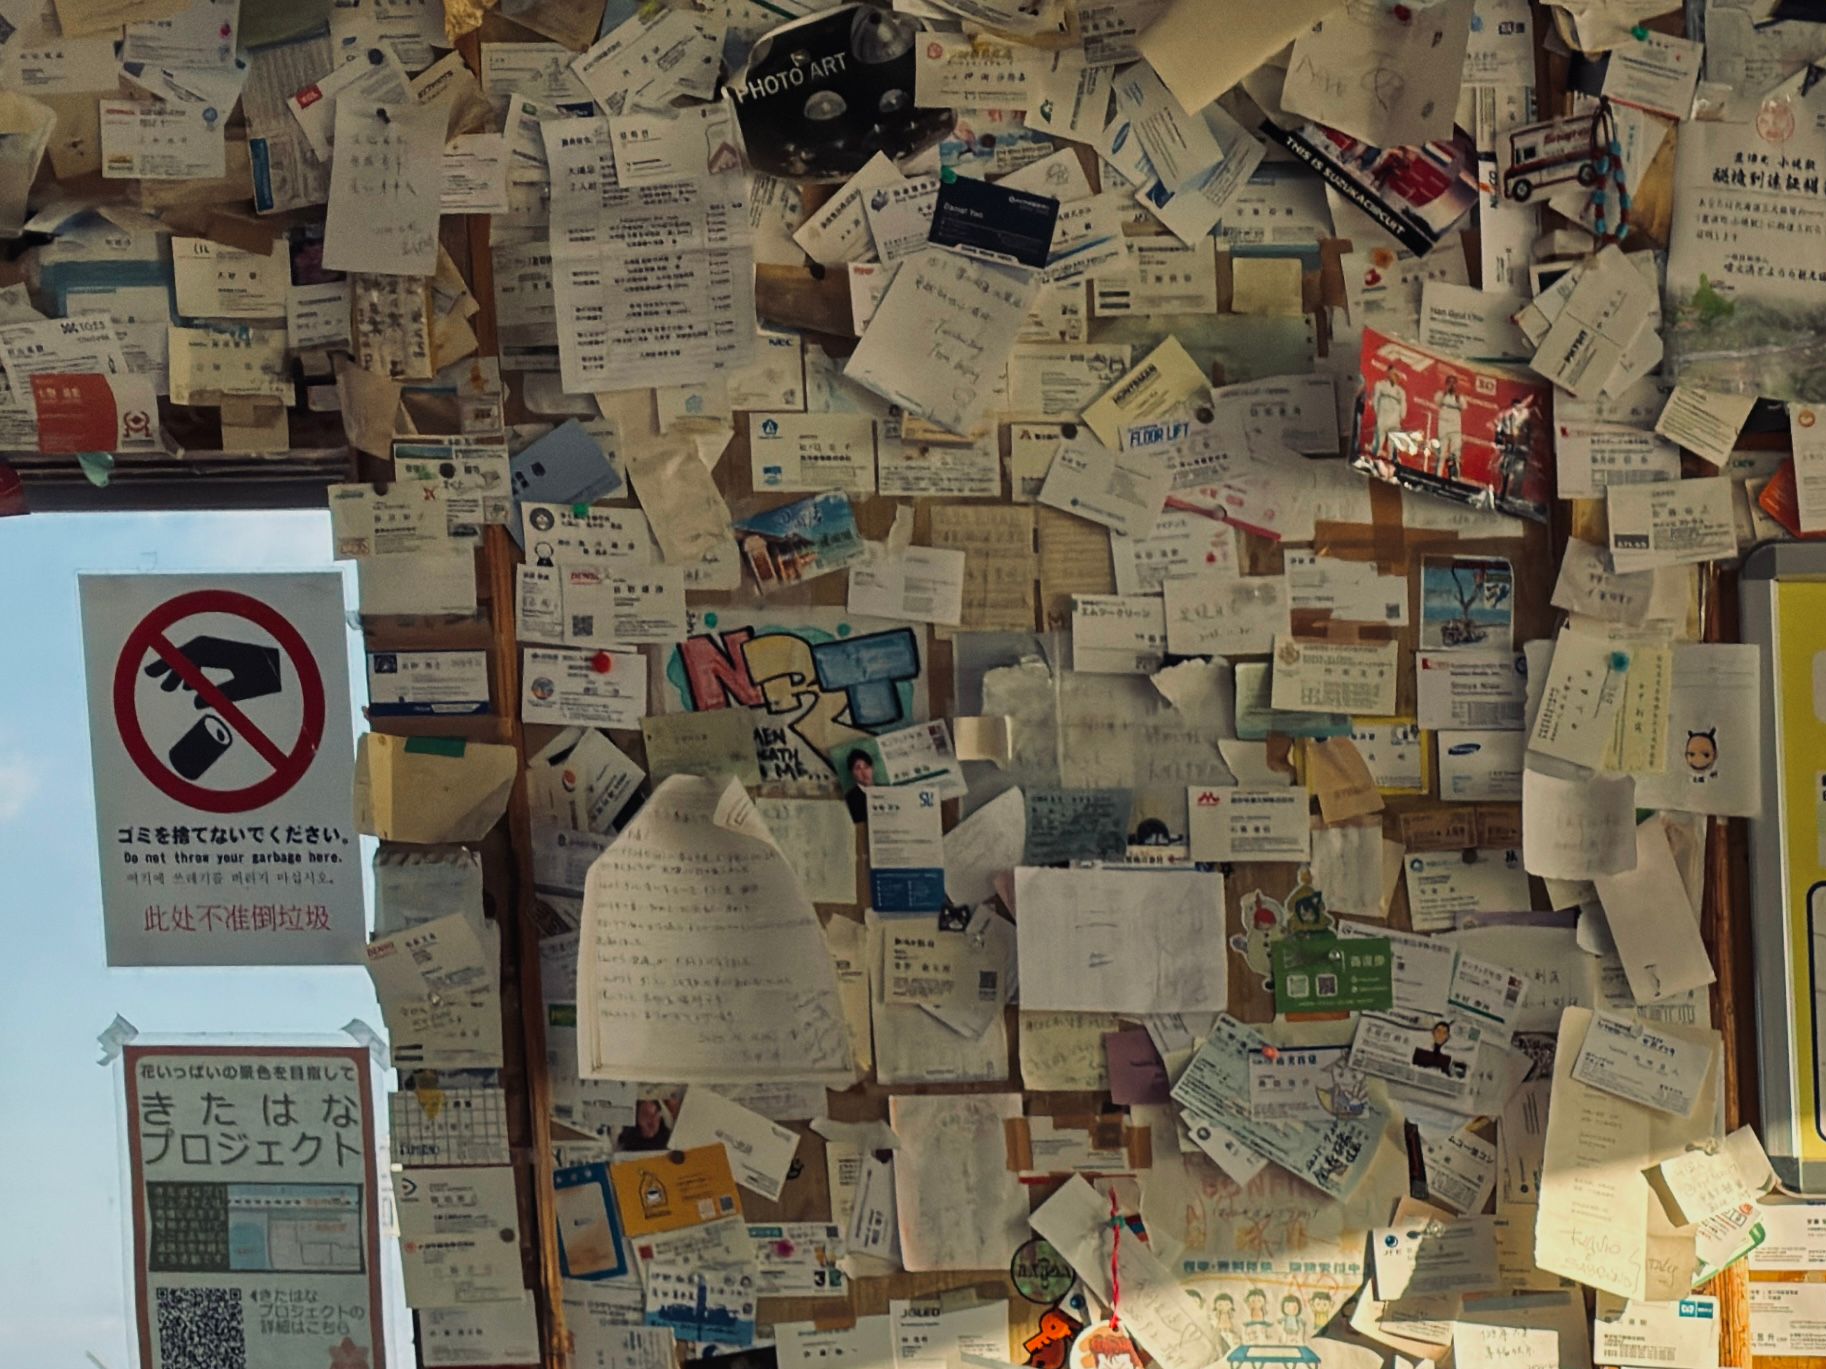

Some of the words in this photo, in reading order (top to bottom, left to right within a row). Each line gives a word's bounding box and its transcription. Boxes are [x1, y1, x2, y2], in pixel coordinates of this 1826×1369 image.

[738, 63, 803, 103] PHOTO
[810, 52, 848, 80] ART
[1284, 134, 1314, 162] THIS
[1310, 156, 1327, 174] IS
[1130, 427, 1164, 448] FLOOR
[1167, 422, 1189, 442] LIFT
[679, 626, 921, 777] NRT
[118, 825, 350, 847] ゴミを捨てないでください。
[124, 851, 140, 864] Do
[145, 851, 167, 864] not
[174, 851, 211, 864] throw
[216, 852, 245, 866] your
[252, 851, 304, 867] garbage
[309, 851, 343, 865] here.
[126, 871, 166, 885] 여기에
[143, 904, 331, 932] 此处不准倒垃圾
[140, 1064, 356, 1081] 花いっぱいの景色を目指して
[143, 1090, 359, 1129] きたはな
[145, 1130, 361, 1168] プロジェクト
